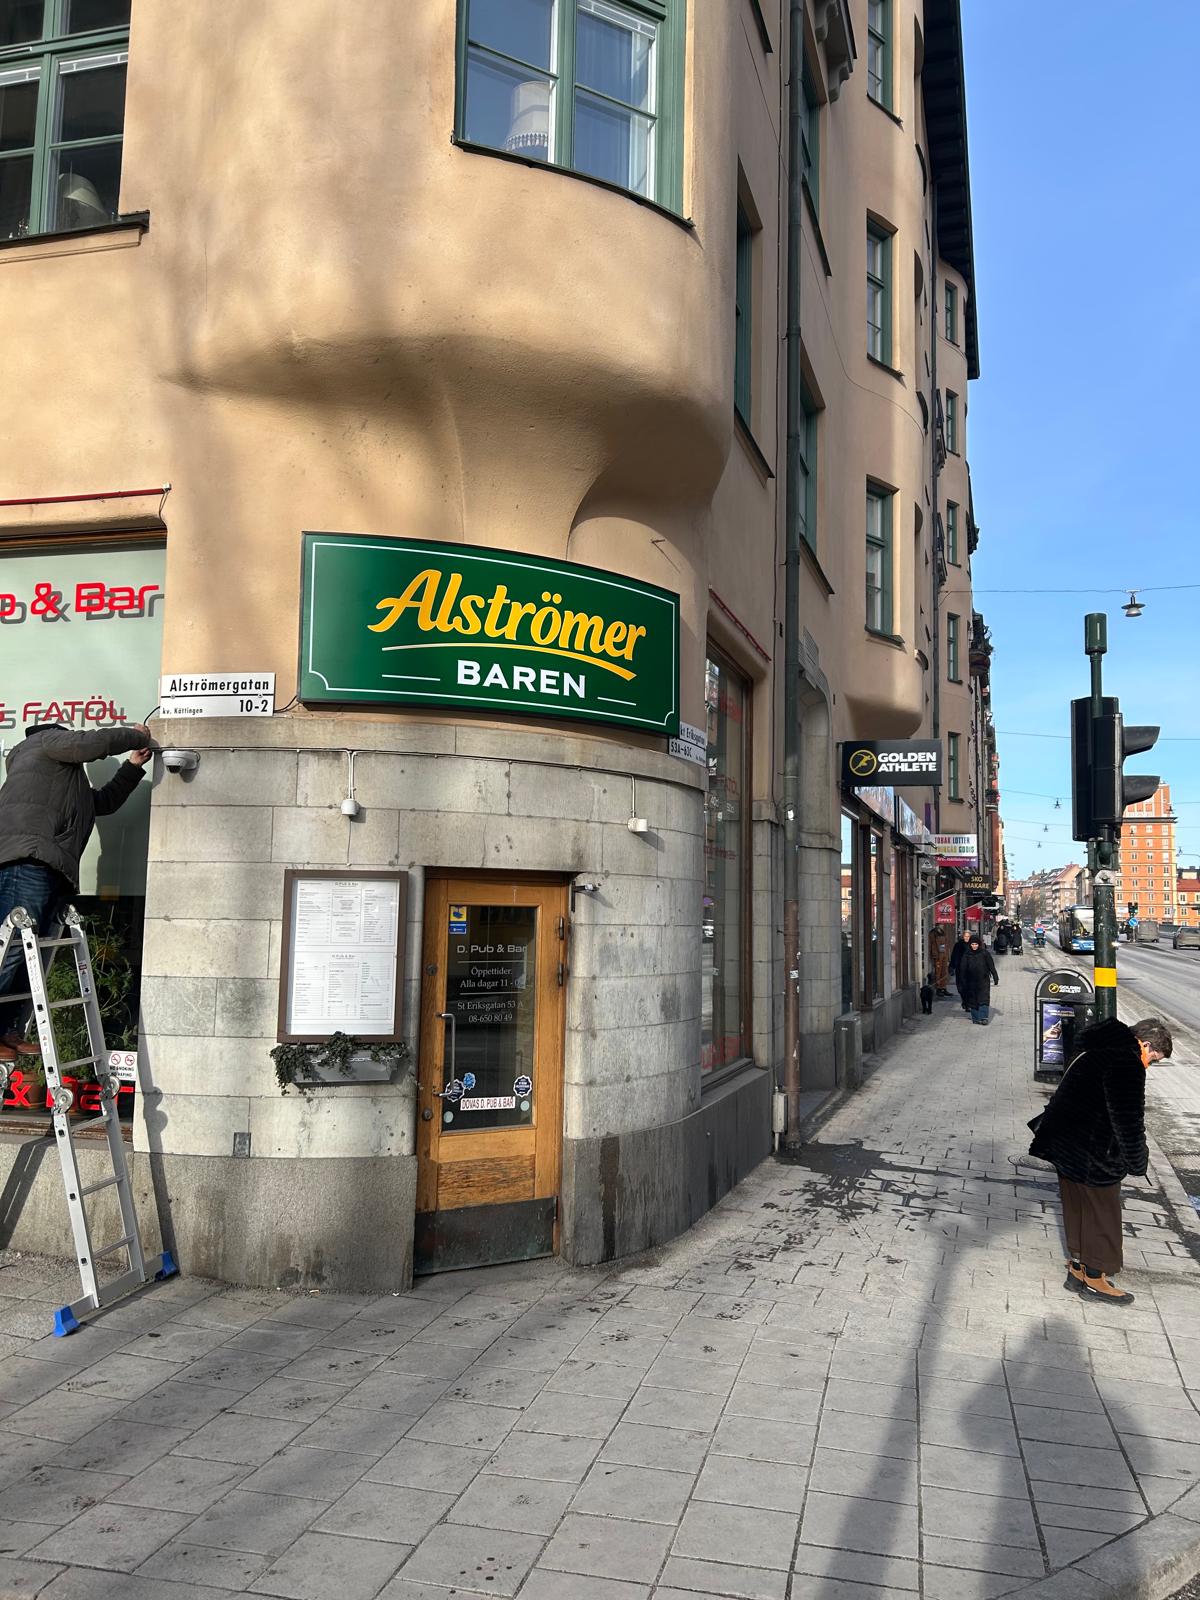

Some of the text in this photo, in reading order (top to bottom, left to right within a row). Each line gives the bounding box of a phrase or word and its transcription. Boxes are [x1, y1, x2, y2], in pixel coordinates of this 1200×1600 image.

[31, 583, 60, 614] &
[75, 582, 159, 612] Bar
[367, 569, 646, 660] Alströmer
[457, 659, 586, 699] BAREN
[170, 679, 269, 693] Alströmergatan
[23, 696, 127, 722] FATÖL
[240, 700, 269, 712] 10-2
[878, 752, 937, 763] GOLDEN
[878, 762, 937, 772] ATHLETE
[457, 944, 527, 953] D. Pub & Bar
[460, 980, 476, 988] Alla
[478, 979, 499, 989] dagar
[501, 979, 508, 987] 11
[458, 1002, 465, 1010] St
[467, 1001, 506, 1011] Eriksgatan
[507, 1000, 516, 1008] 53
[487, 1098, 497, 1108] PUB
[503, 1097, 514, 1107] BAR
